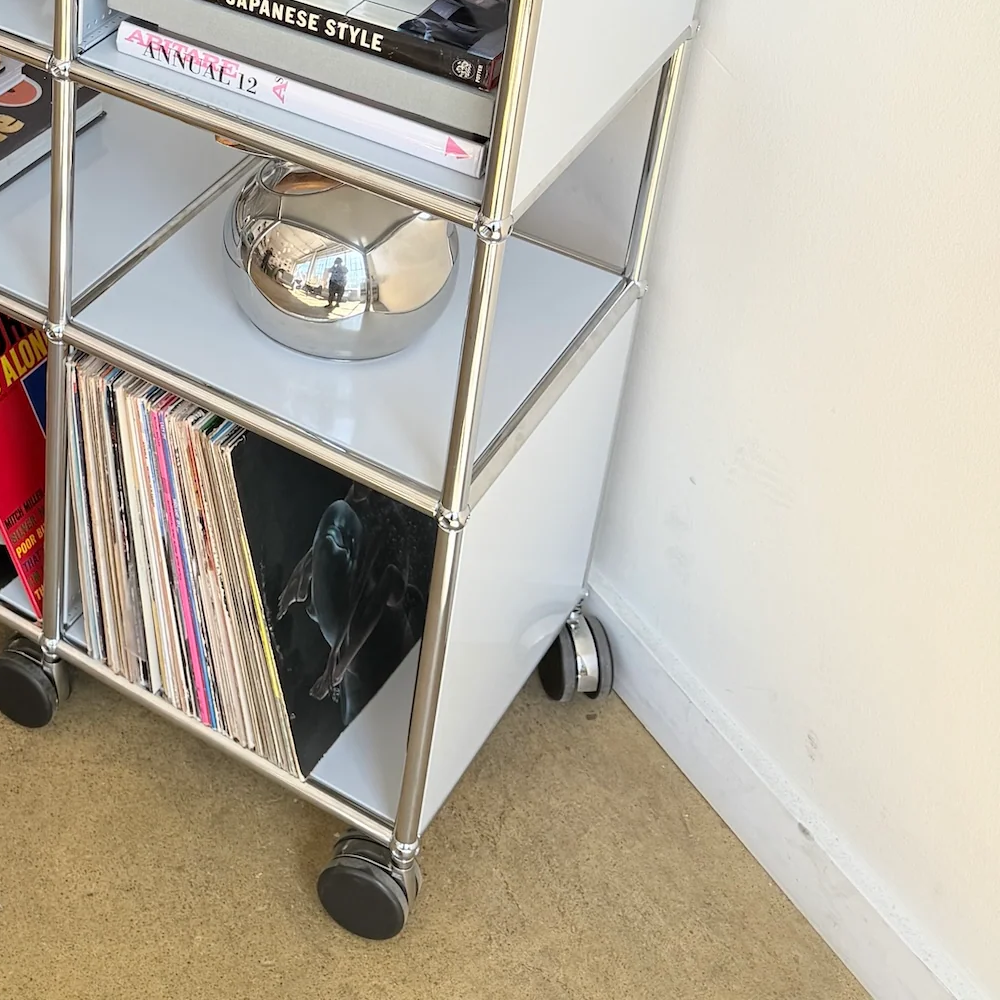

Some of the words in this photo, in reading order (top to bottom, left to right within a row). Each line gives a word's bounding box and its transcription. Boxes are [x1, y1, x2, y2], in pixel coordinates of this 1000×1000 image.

[125, 28, 240, 78] ABITARE
[324, 18, 384, 52] STYLE
[143, 41, 230, 86] ANNUAL
[238, 72, 258, 95] 12
[0, 328, 48, 388] ALON
[15, 534, 37, 559] POOR
